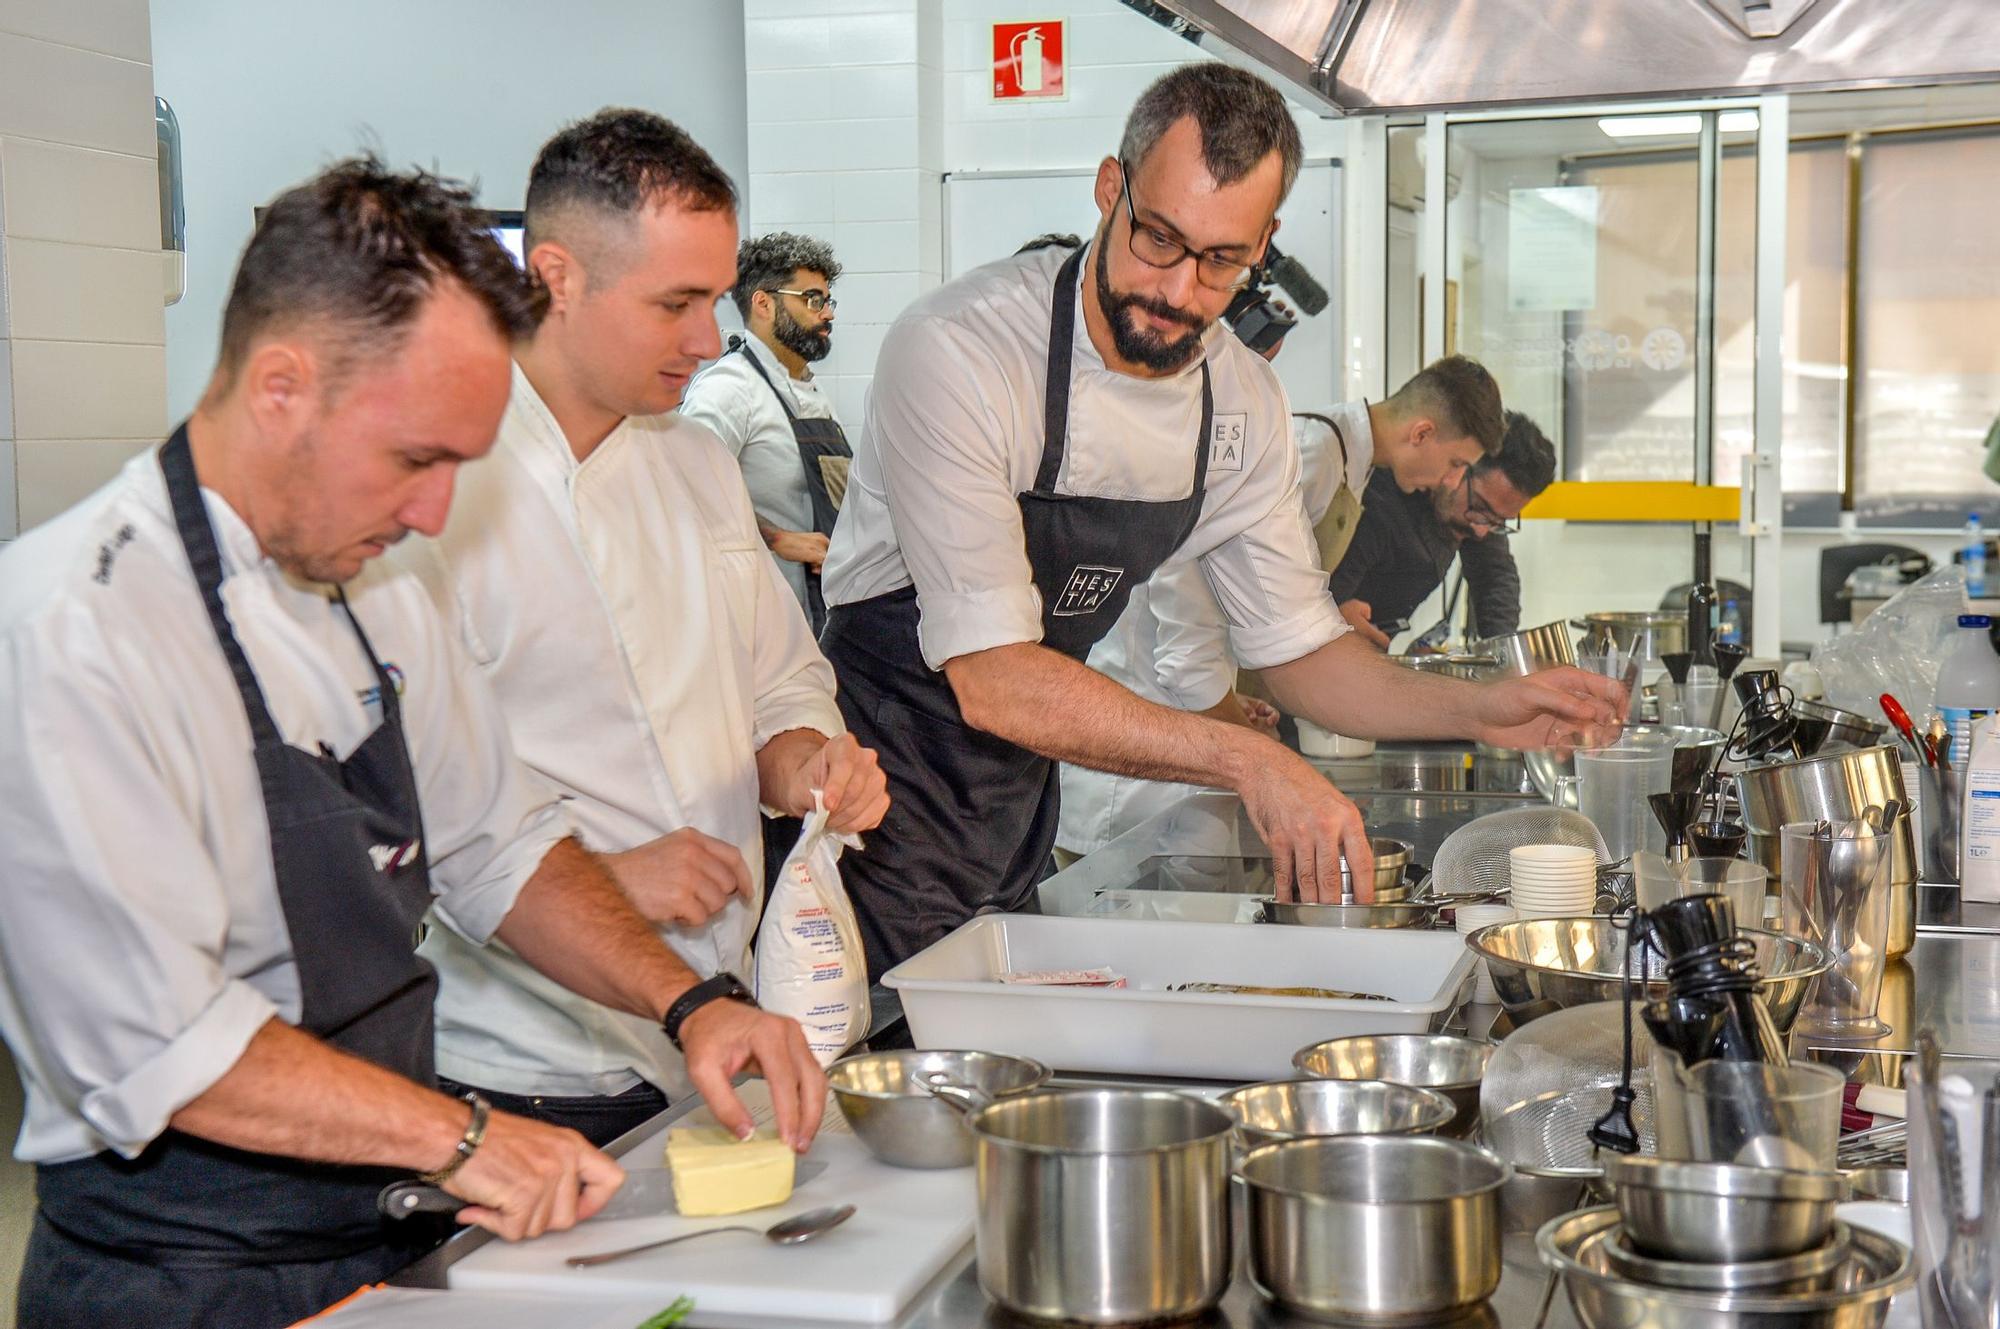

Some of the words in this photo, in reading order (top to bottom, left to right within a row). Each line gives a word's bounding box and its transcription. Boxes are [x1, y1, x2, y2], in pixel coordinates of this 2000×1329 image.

[1215, 424, 1241, 441] ES
[1213, 445, 1236, 462] IA
[1070, 573, 1113, 592] HES
[1066, 592, 1099, 607] TIA
